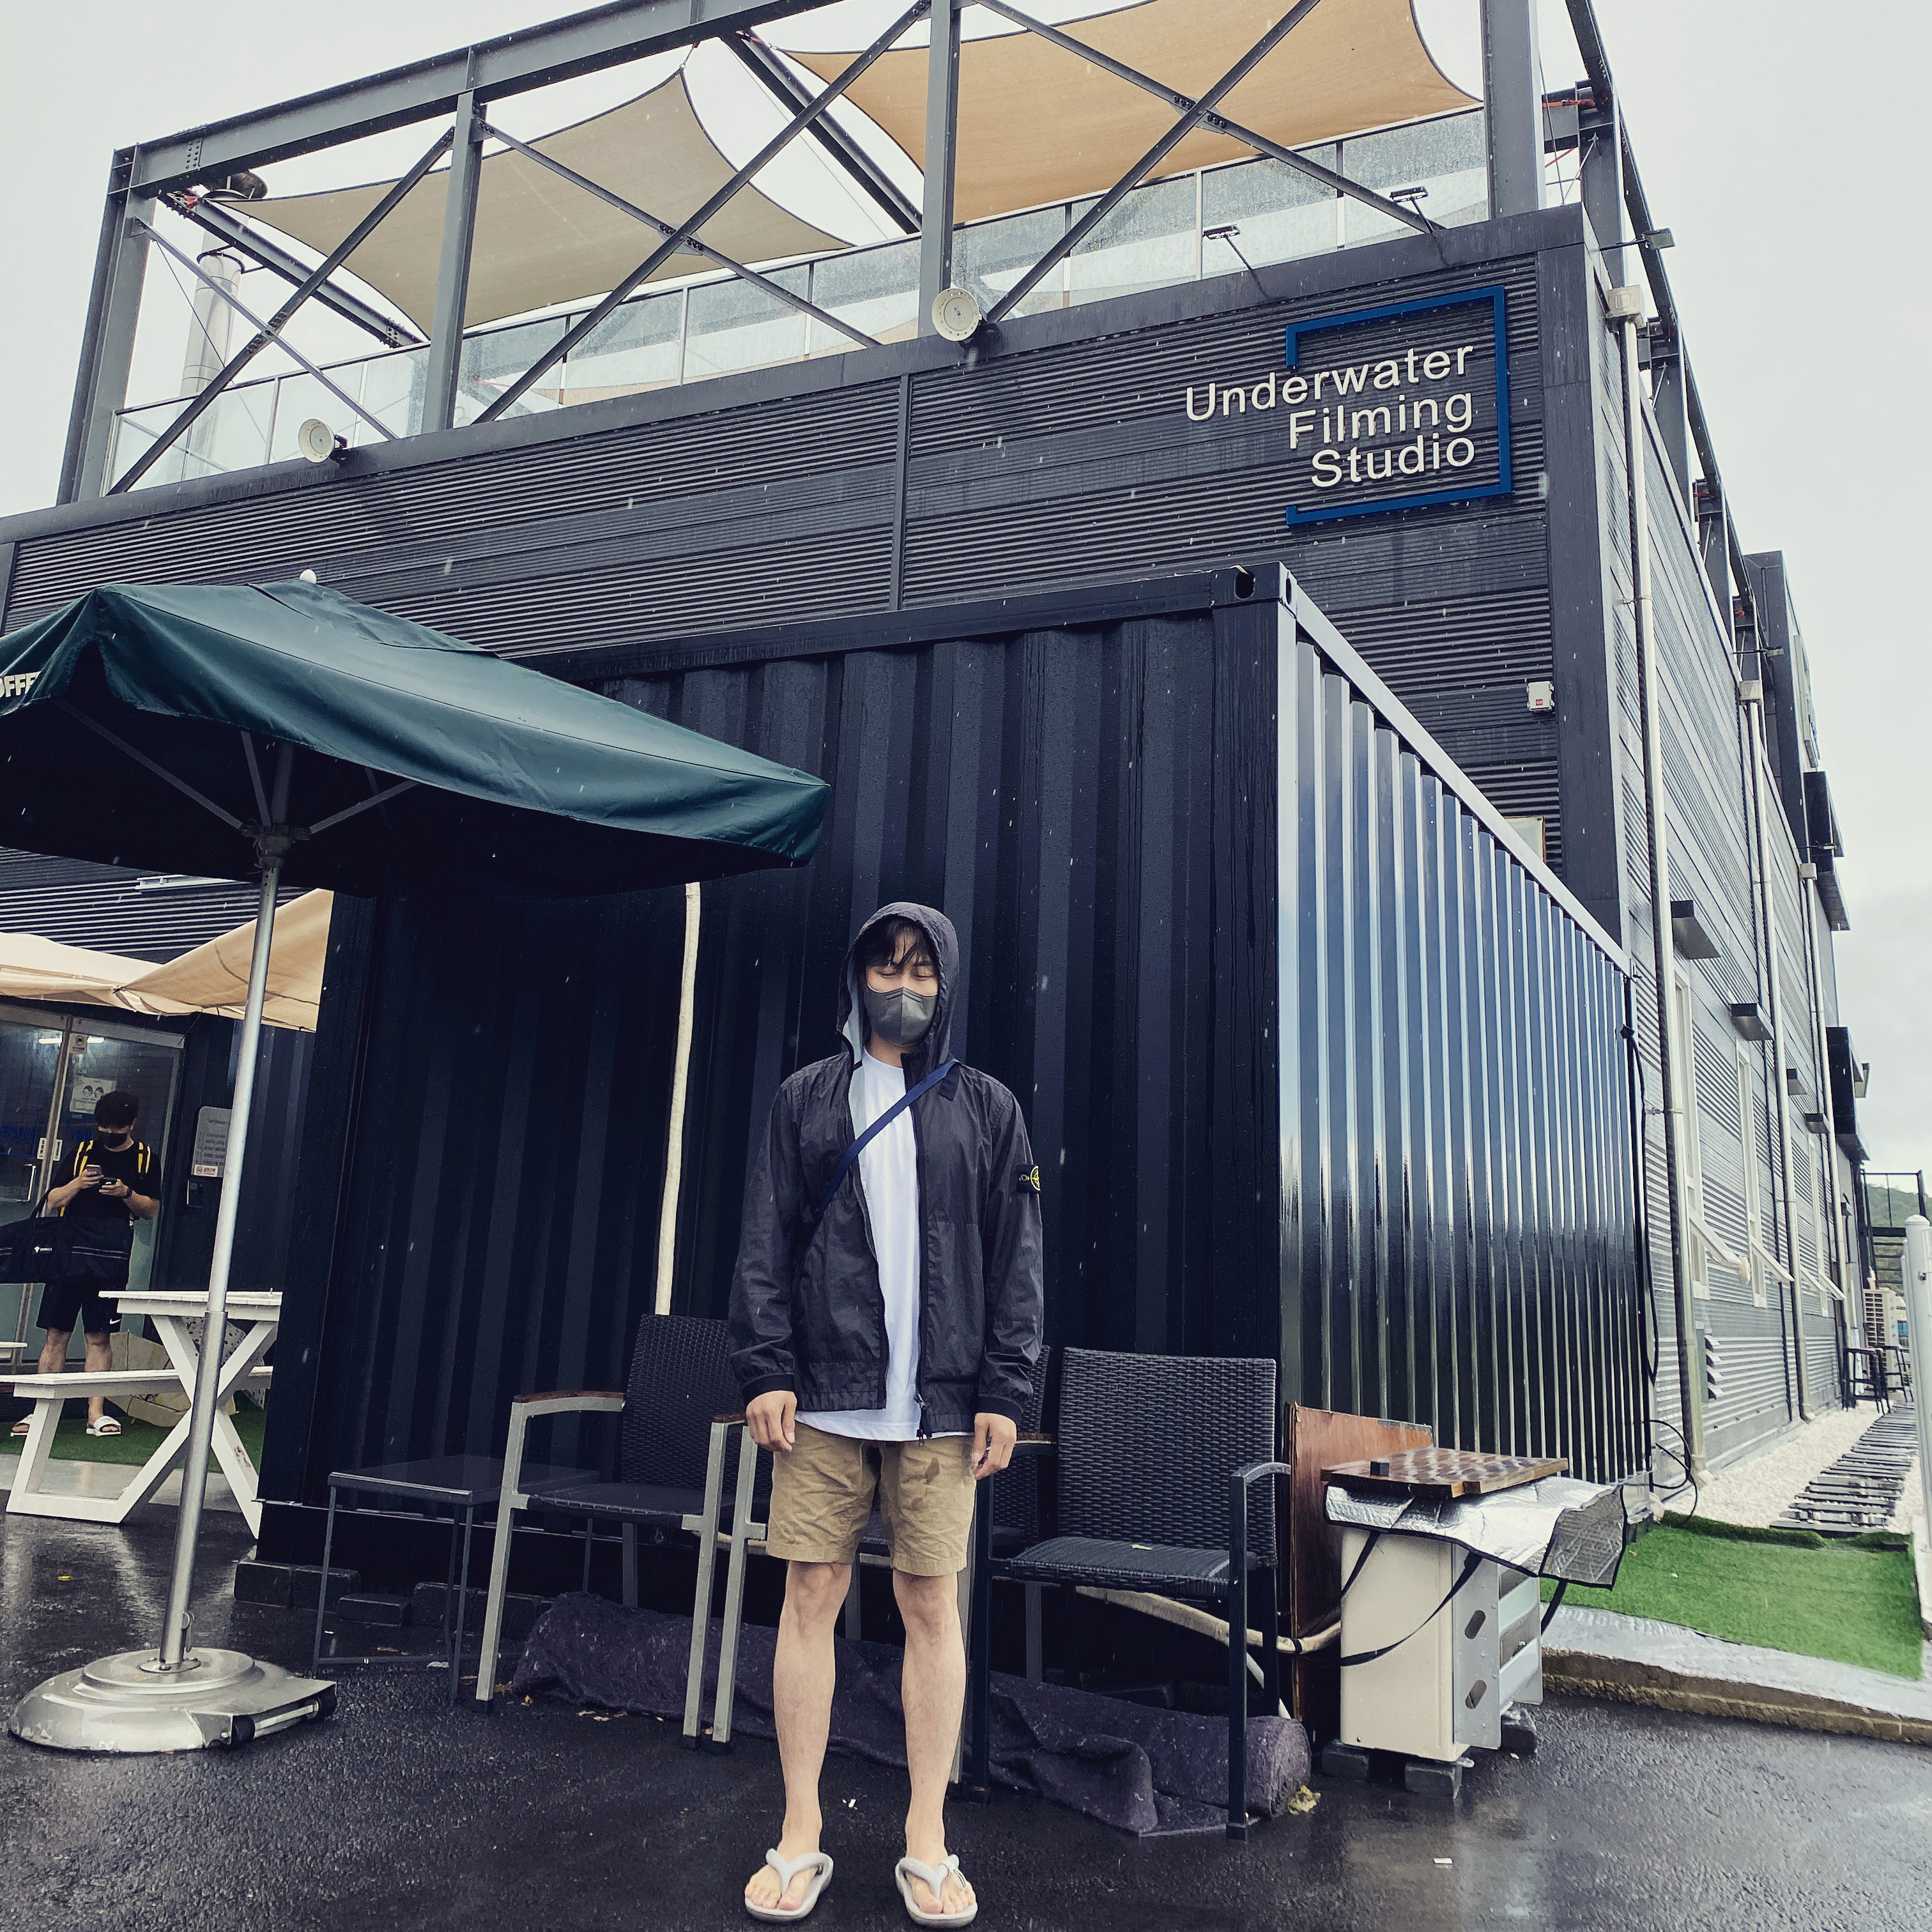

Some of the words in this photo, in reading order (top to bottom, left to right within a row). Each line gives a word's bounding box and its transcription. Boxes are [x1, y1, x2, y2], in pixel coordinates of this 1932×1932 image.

[1186, 345, 1474, 422] Underwater
[1289, 392, 1473, 450] Filming
[1310, 433, 1475, 487] Studio
